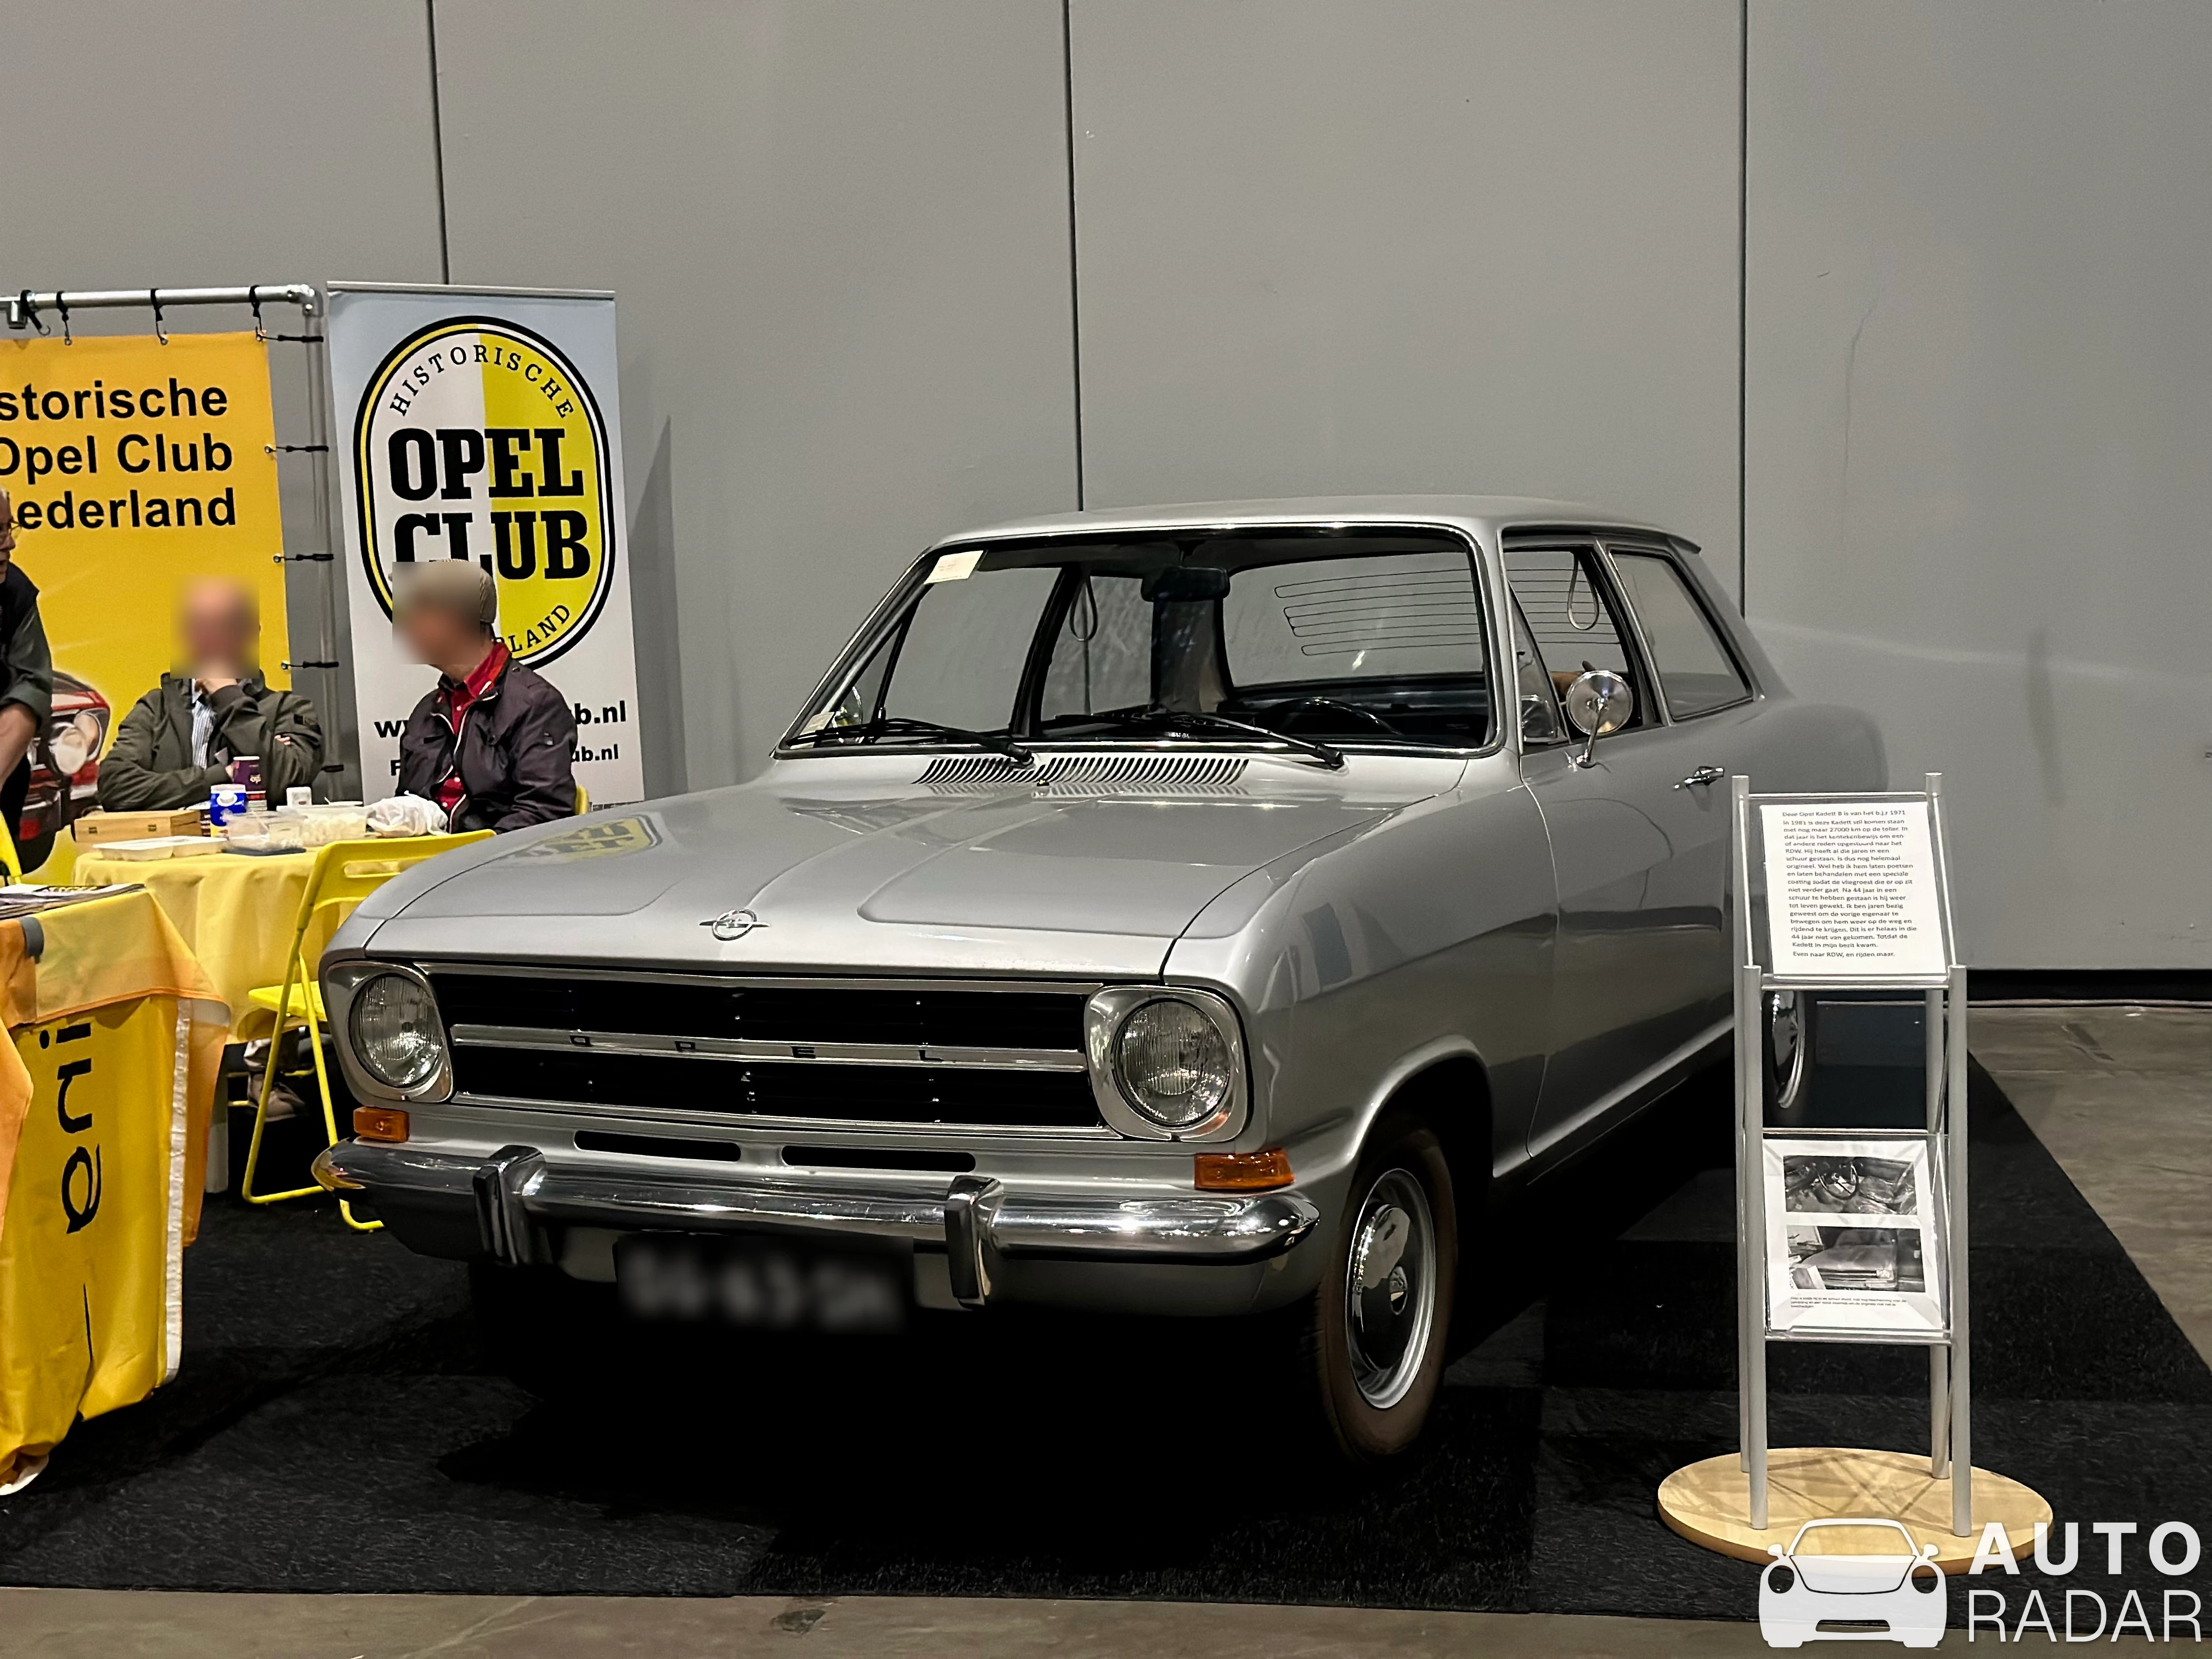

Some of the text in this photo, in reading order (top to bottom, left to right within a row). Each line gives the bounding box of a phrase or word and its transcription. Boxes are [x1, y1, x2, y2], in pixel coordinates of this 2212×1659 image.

[390, 344, 574, 419] HISTORISCHE
[0, 432, 233, 485] Opel Club
[388, 427, 584, 501] OPEL
[15, 487, 236, 530] ederland
[496, 605, 570, 653] LAND
[569, 1034, 944, 1063] OPEL
